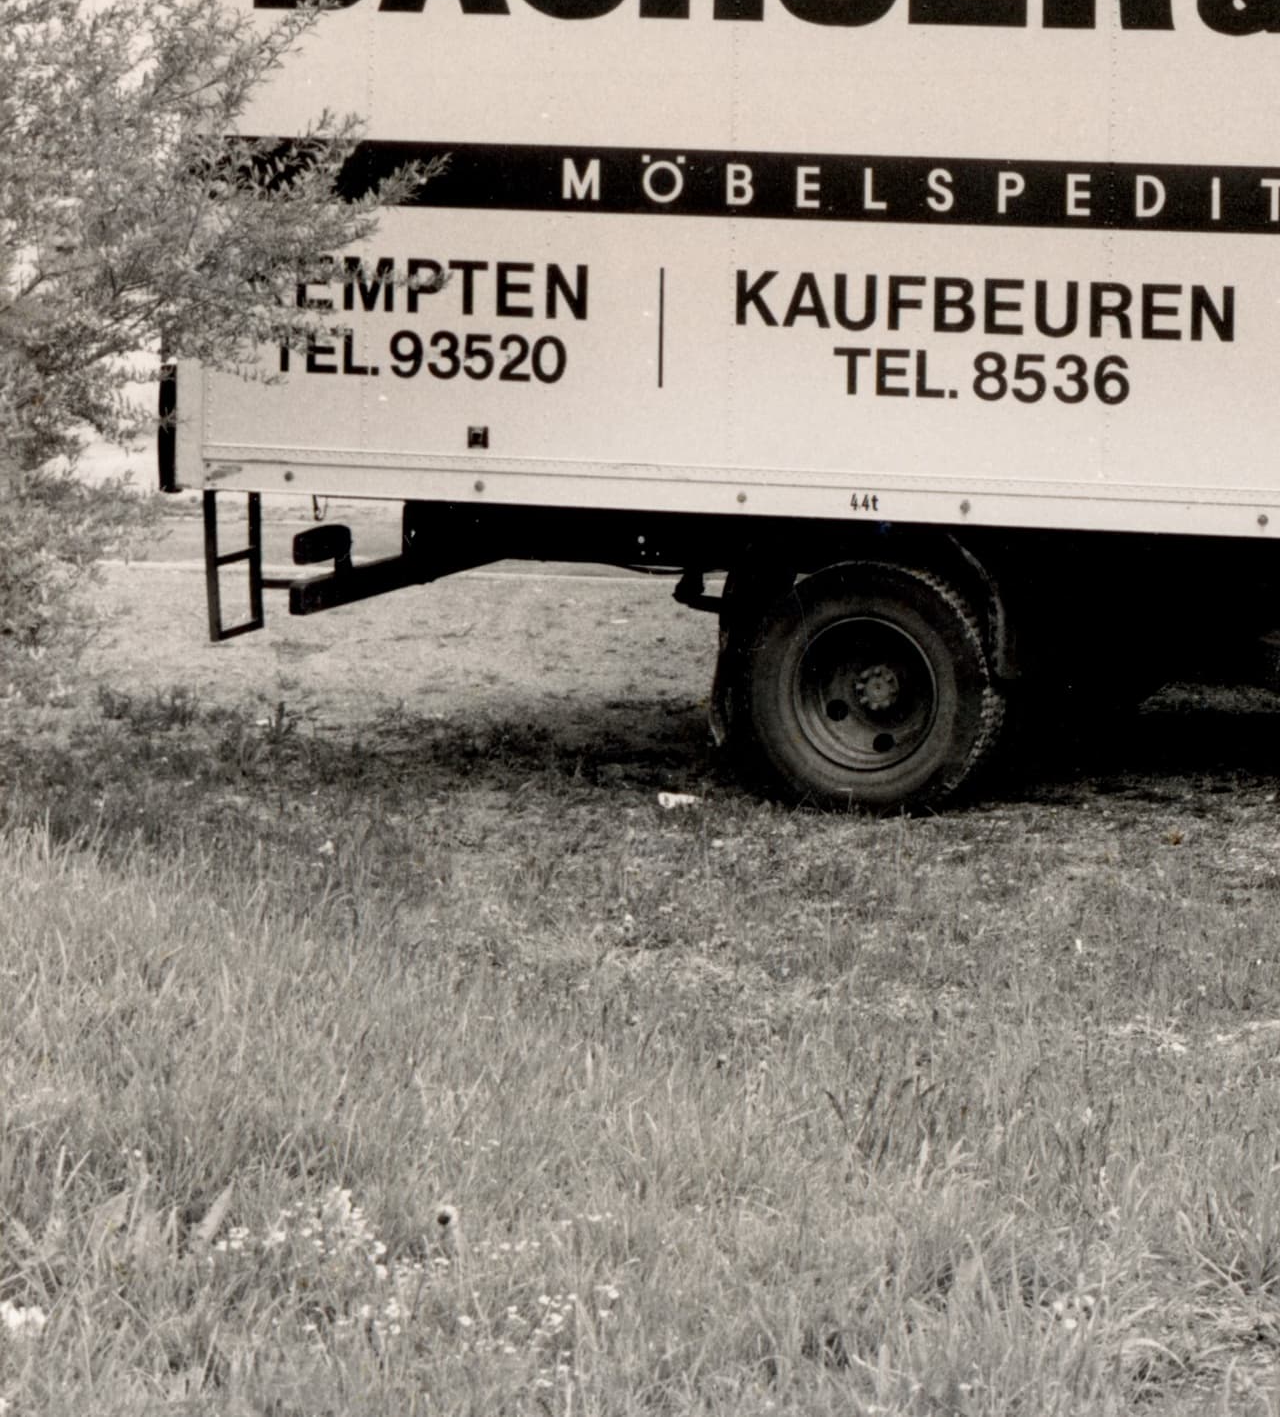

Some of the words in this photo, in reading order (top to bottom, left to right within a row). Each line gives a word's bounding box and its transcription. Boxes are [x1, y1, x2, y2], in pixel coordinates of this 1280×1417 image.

[262, 255, 589, 321] EMPTEN
[735, 269, 1236, 344] KAUFBEUREN
[833, 346, 959, 401] TEL.
[972, 351, 1131, 406] 8536
